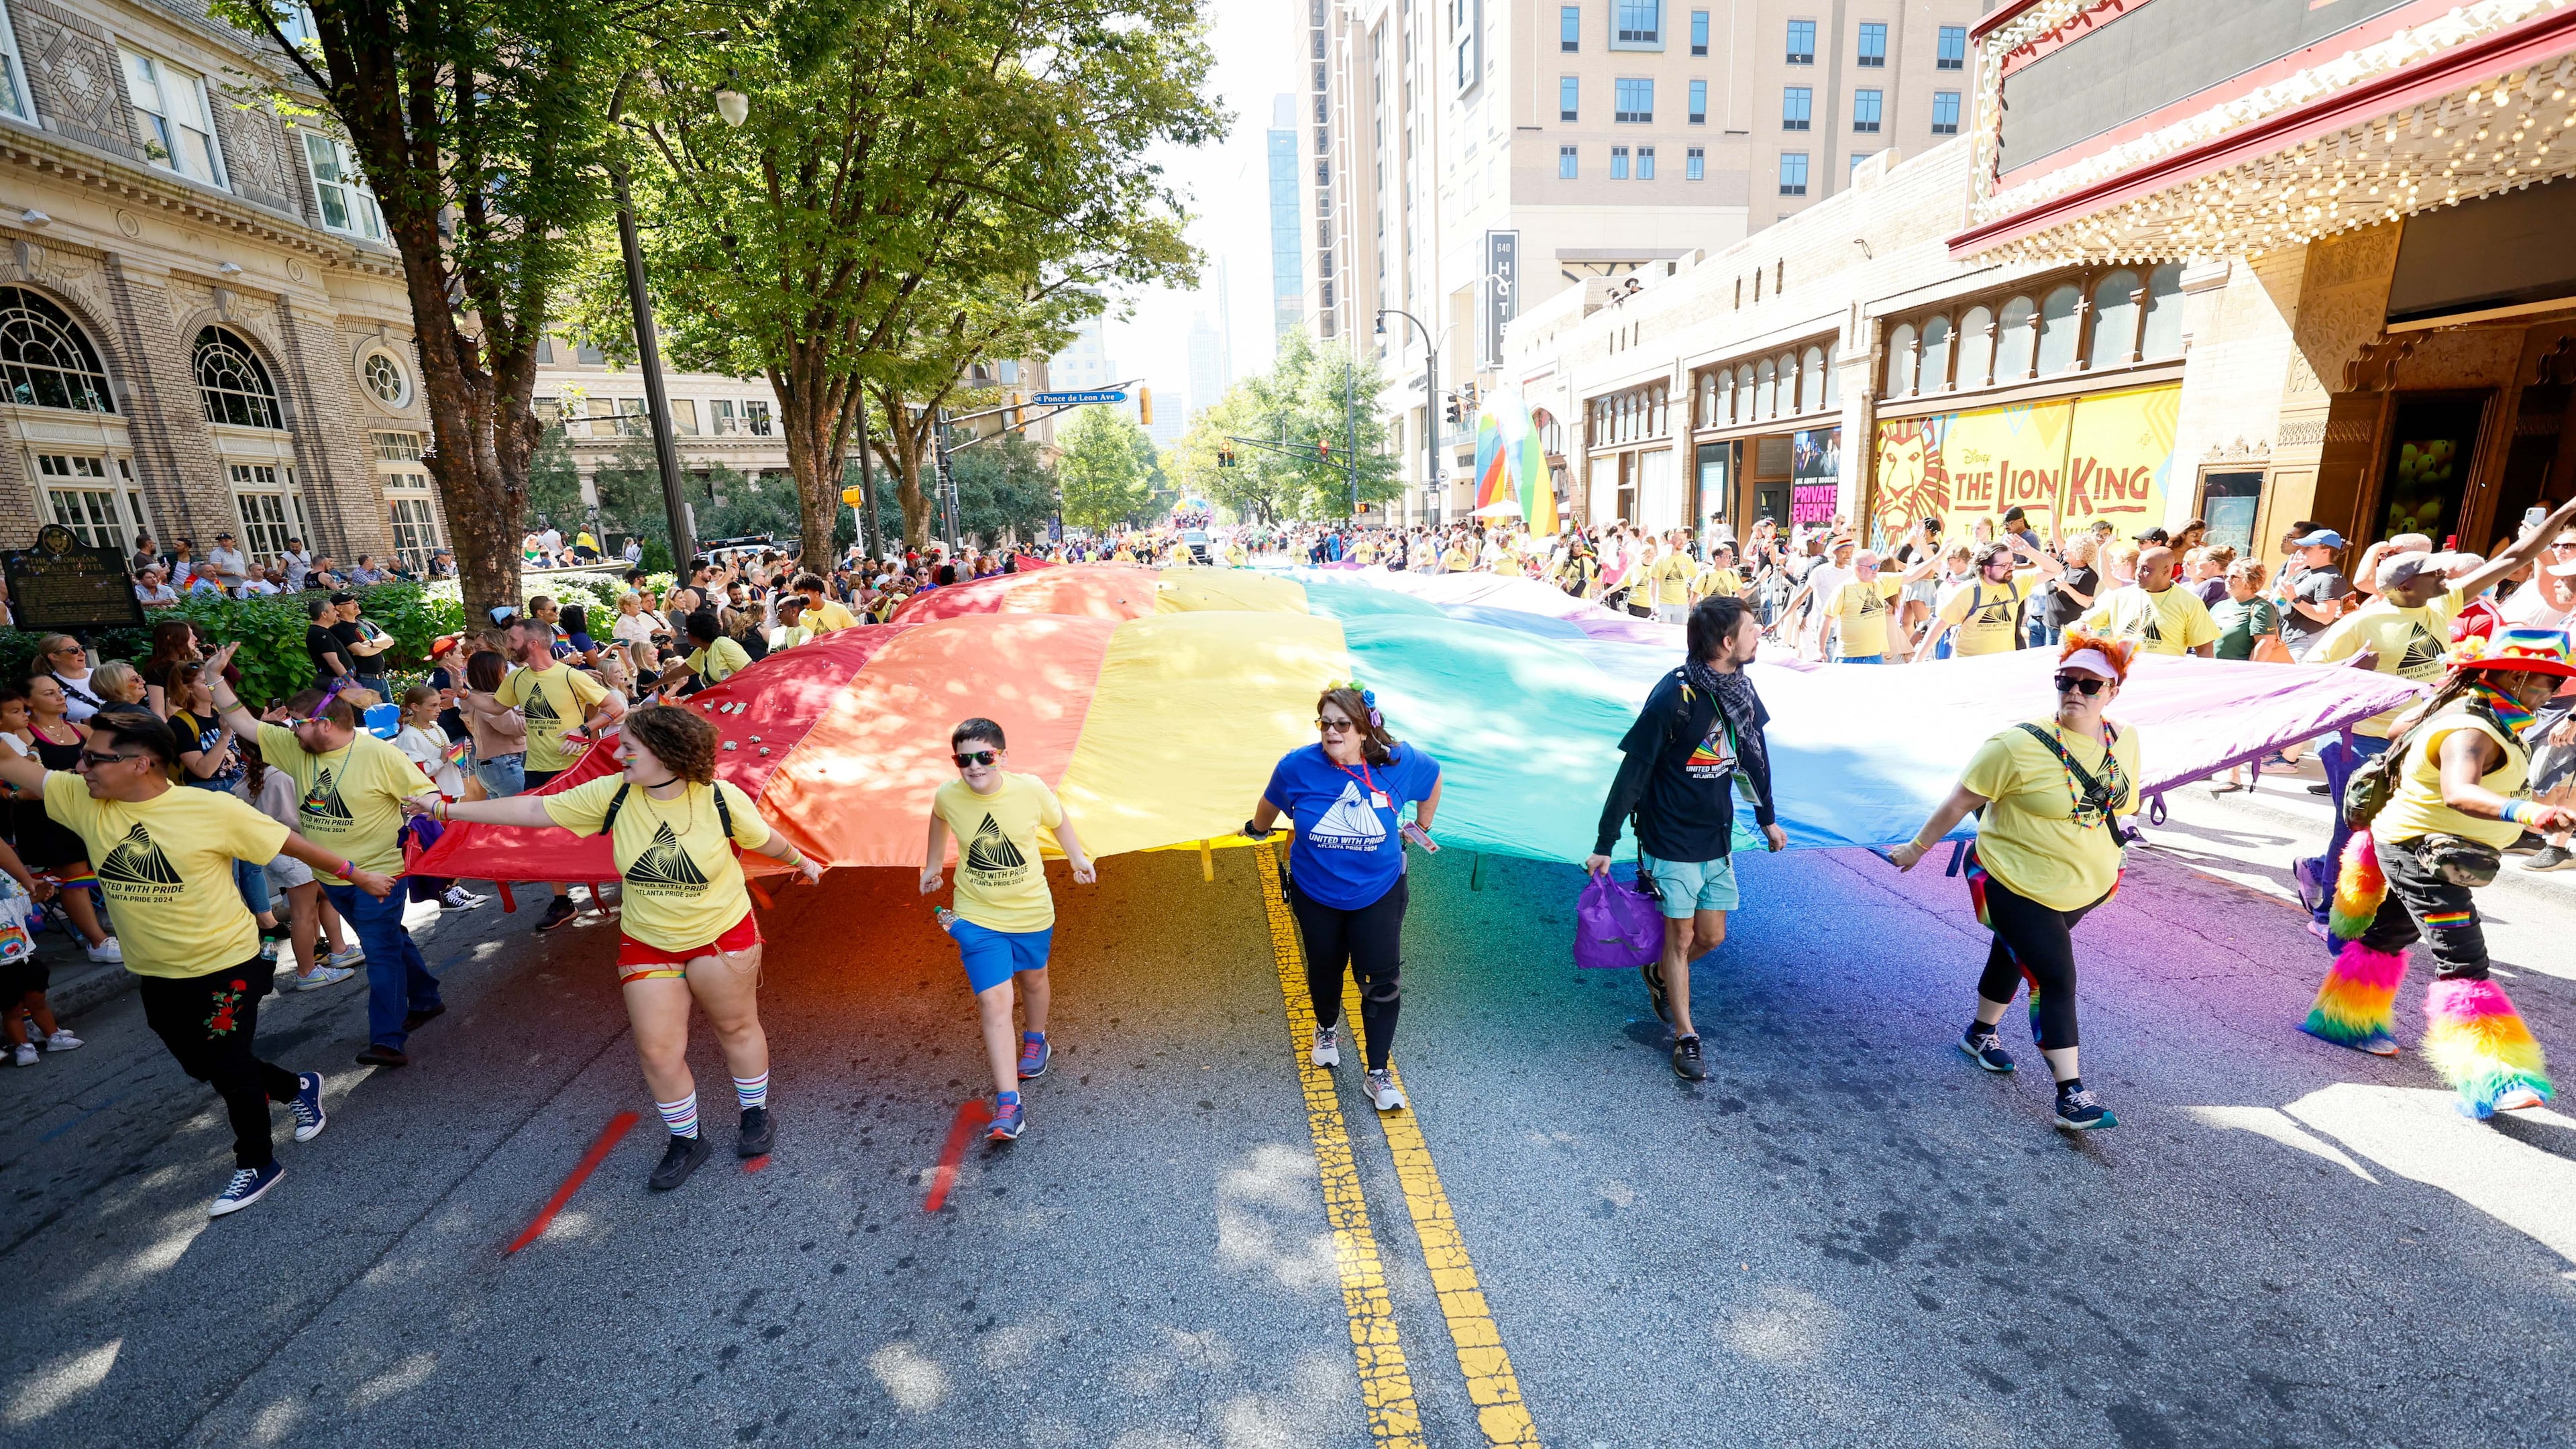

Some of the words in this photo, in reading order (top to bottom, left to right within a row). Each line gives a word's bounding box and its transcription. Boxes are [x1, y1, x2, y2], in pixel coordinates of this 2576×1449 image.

[1497, 243, 1511, 253] 640
[1043, 394, 1065, 402] Ponce
[1818, 476, 1837, 484] BOOKING
[1955, 472, 1993, 500] THE
[1997, 460, 2059, 515] LION
[2067, 456, 2150, 516] KING
[1793, 485, 1837, 503] PRIVATE
[1792, 503, 1835, 523] EVENTS
[30, 557, 48, 565] THE
[52, 555, 98, 564] GEORGIAN
[2396, 664, 2423, 676] UNITED
[2406, 671, 2429, 680] ATLANTA
[1686, 765, 1710, 773] UNITED
[313, 817, 331, 825] WITH
[1308, 833, 1339, 843] UNITED
[1340, 837, 1363, 845] WITH
[1364, 835, 1387, 845] PRIDE
[987, 871, 1008, 879] WITH
[1009, 865, 1028, 877] PRIDE
[627, 879, 656, 888] UNITED
[684, 883, 709, 892] PRIDE
[969, 877, 993, 887] ATLANTA
[1012, 877, 1024, 885] 2024
[125, 883, 150, 894] WITH
[152, 884, 186, 894] PRIDE
[635, 888, 664, 897] ATLANTA
[665, 890, 684, 898] PRIDE
